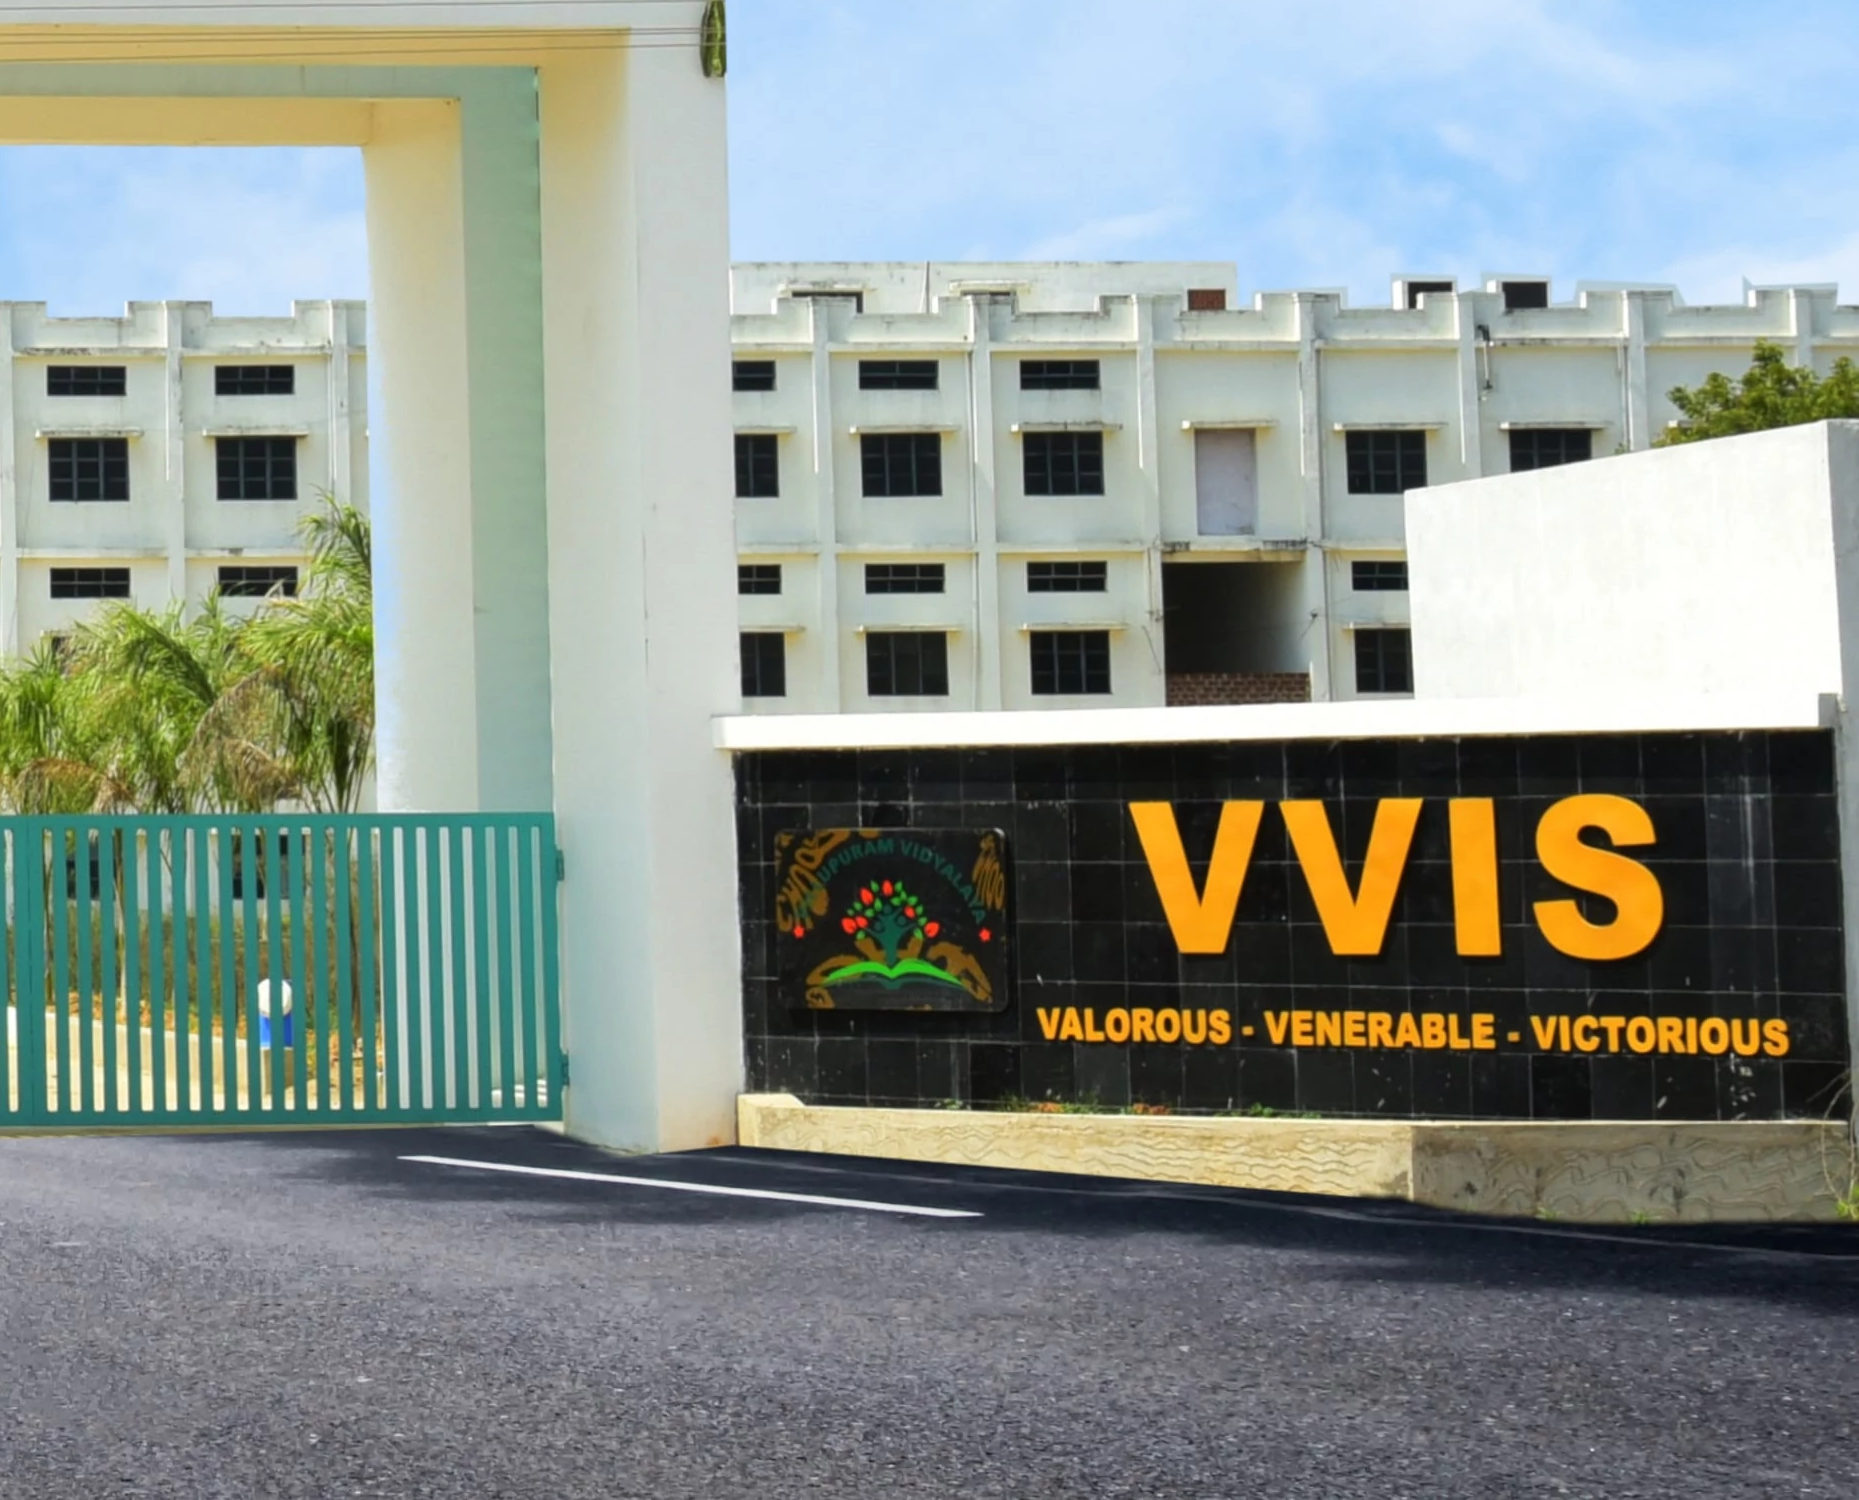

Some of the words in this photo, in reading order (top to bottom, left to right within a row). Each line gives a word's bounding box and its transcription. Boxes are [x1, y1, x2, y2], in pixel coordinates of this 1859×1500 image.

[900, 838, 987, 925] VIDYALAYA
[1128, 792, 1666, 962] VVIS
[1036, 1006, 1233, 1046] VALOROUS
[1263, 1009, 1497, 1052] VENERABLE
[1530, 1014, 1792, 1058] VICTORIOUS
